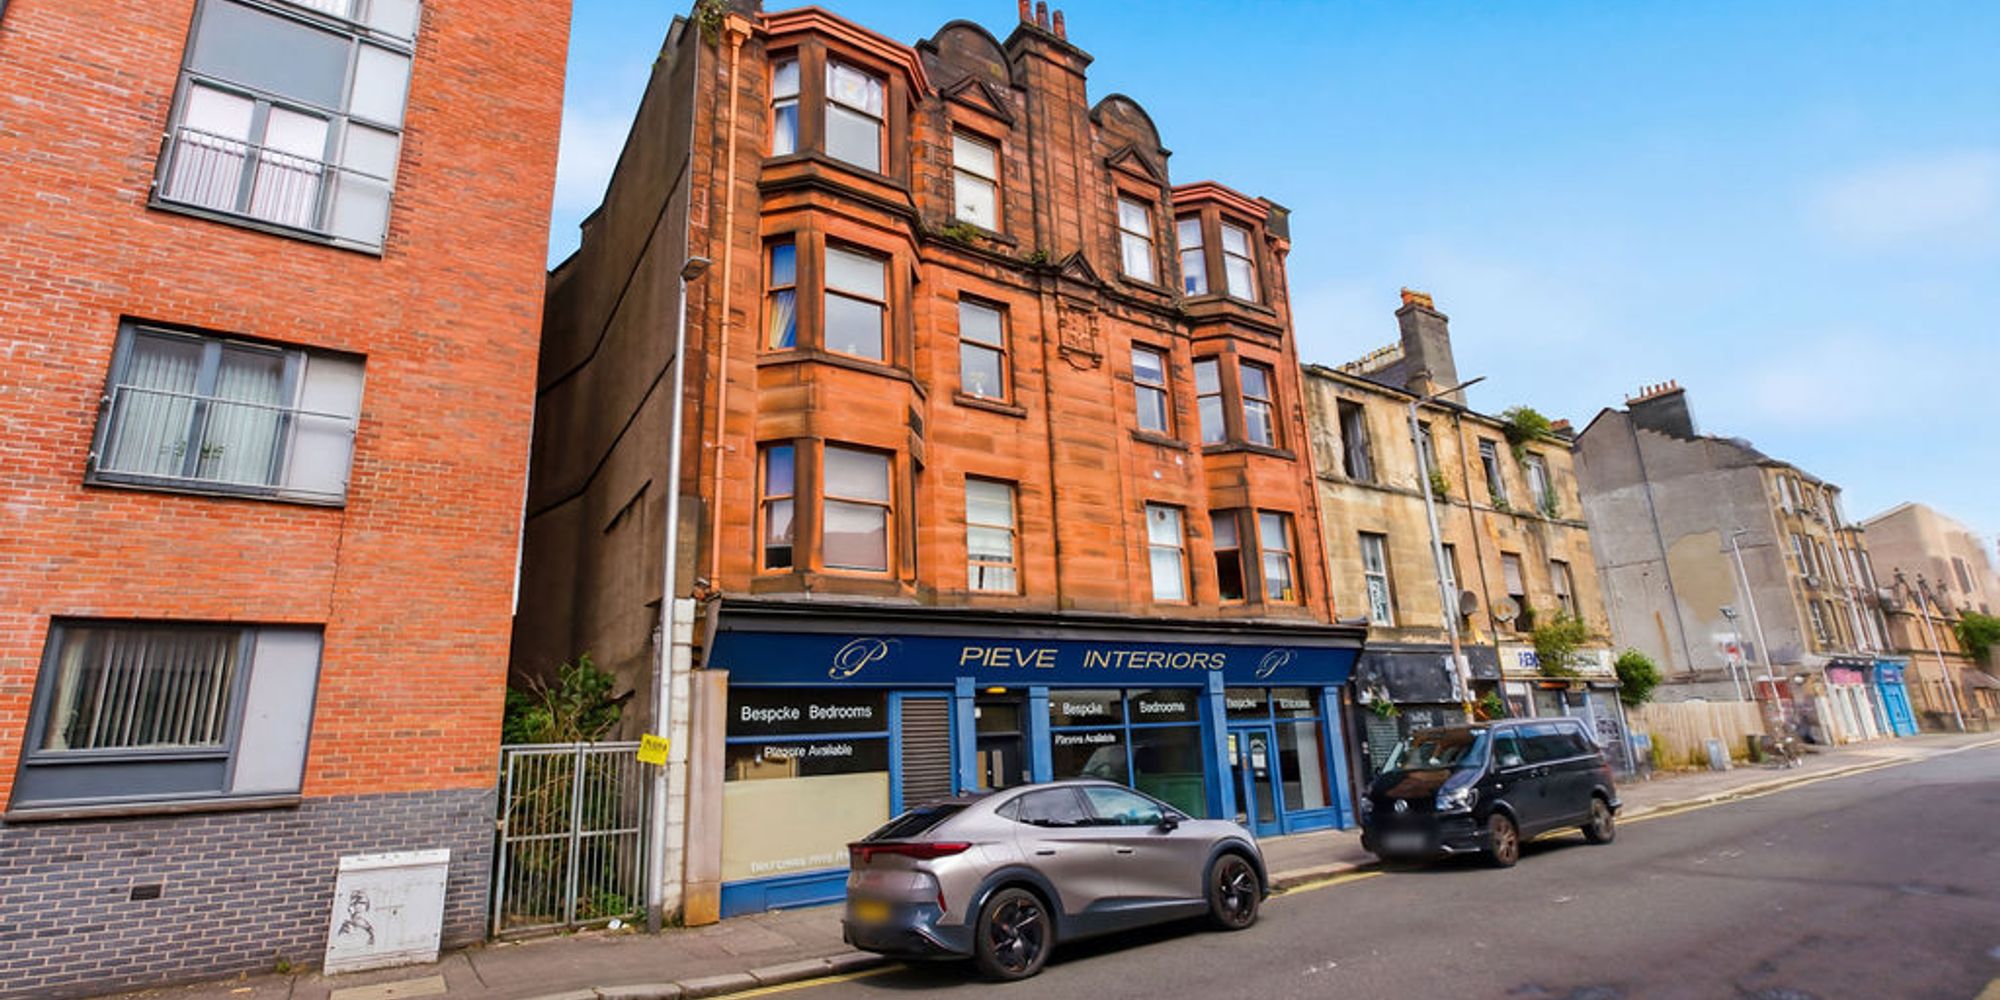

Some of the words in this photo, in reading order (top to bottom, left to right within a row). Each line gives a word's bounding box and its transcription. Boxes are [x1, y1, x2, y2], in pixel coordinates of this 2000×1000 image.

[959, 647, 1058, 669] PIEVE
[1083, 650, 1226, 670] INTERIORS
[808, 703, 873, 719] Bedrooms
